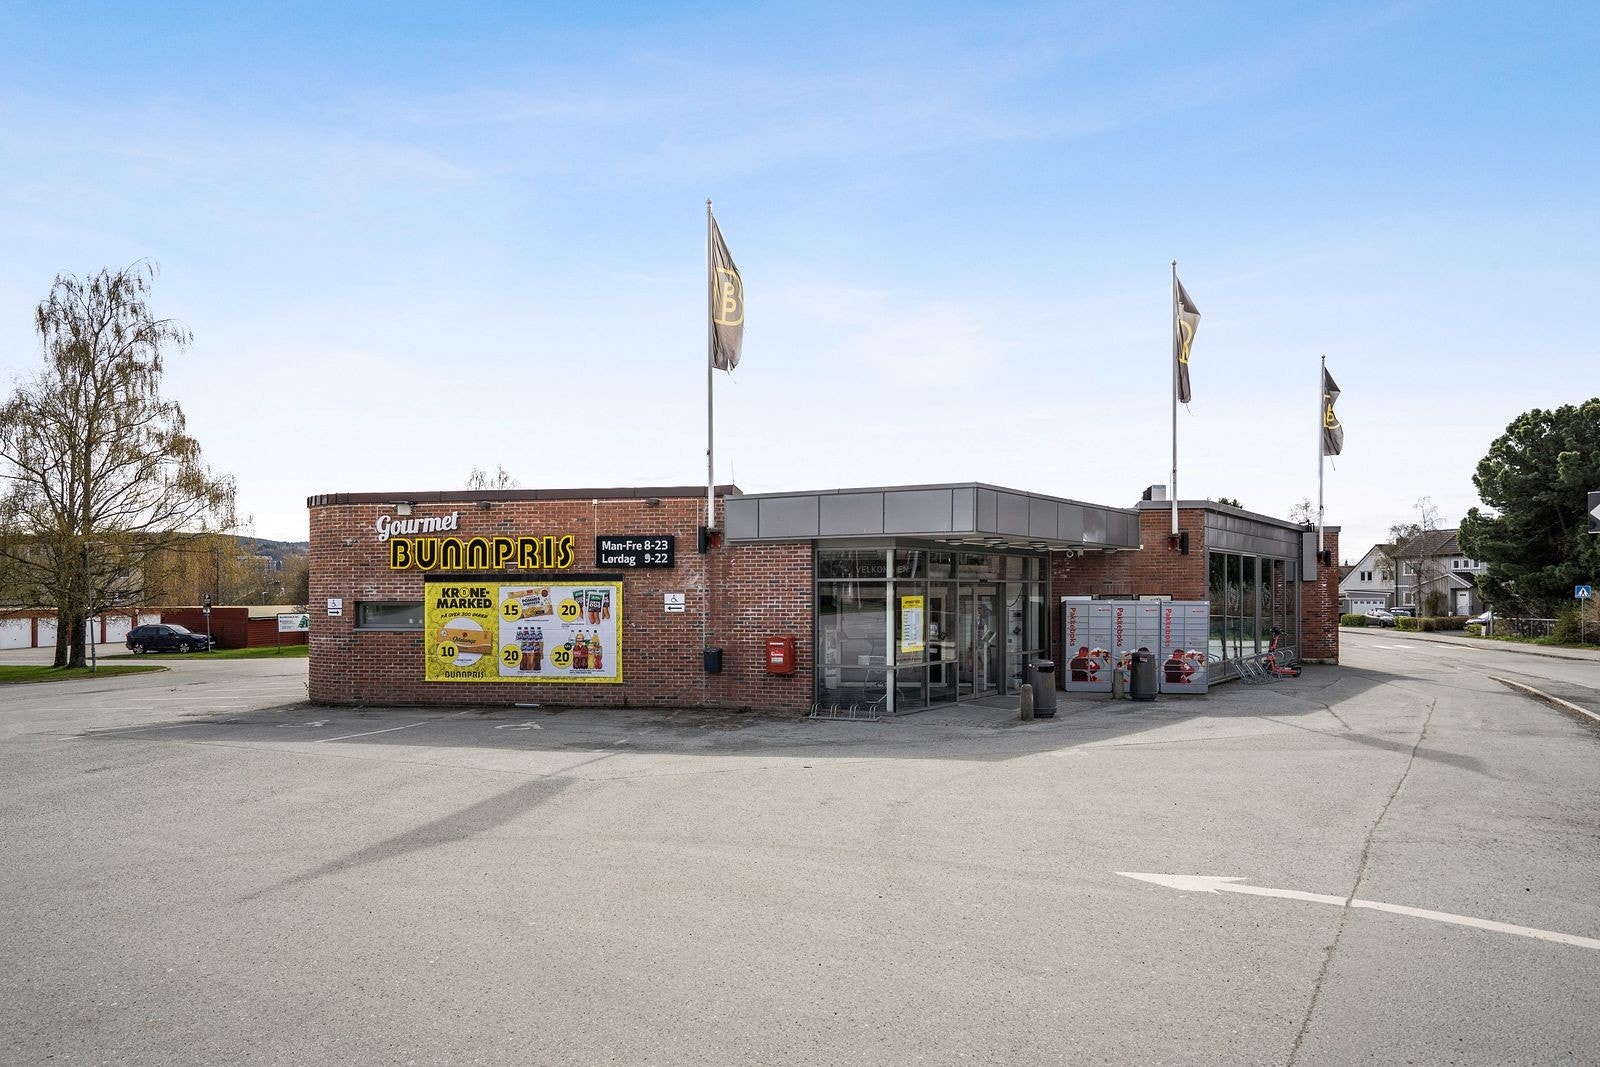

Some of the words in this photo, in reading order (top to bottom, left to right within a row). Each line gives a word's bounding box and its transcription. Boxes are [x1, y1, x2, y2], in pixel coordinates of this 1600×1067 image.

[376, 511, 459, 541] Gourmet
[602, 540, 642, 551] Man-Fre
[644, 540, 668, 551] 8-23
[390, 534, 575, 570] BUNNPRIS
[602, 553, 636, 566] Lørdag
[644, 553, 668, 564] 9-22
[436, 598, 492, 609] MARKED
[504, 605, 519, 616] 15
[561, 605, 576, 616] 20
[1069, 607, 1077, 647] Pakkeboks
[1116, 607, 1124, 648] Pakkeboks
[441, 646, 455, 657] 10
[504, 650, 519, 661] 20
[555, 652, 570, 662] 20
[445, 670, 484, 678] BUNNPRIS
